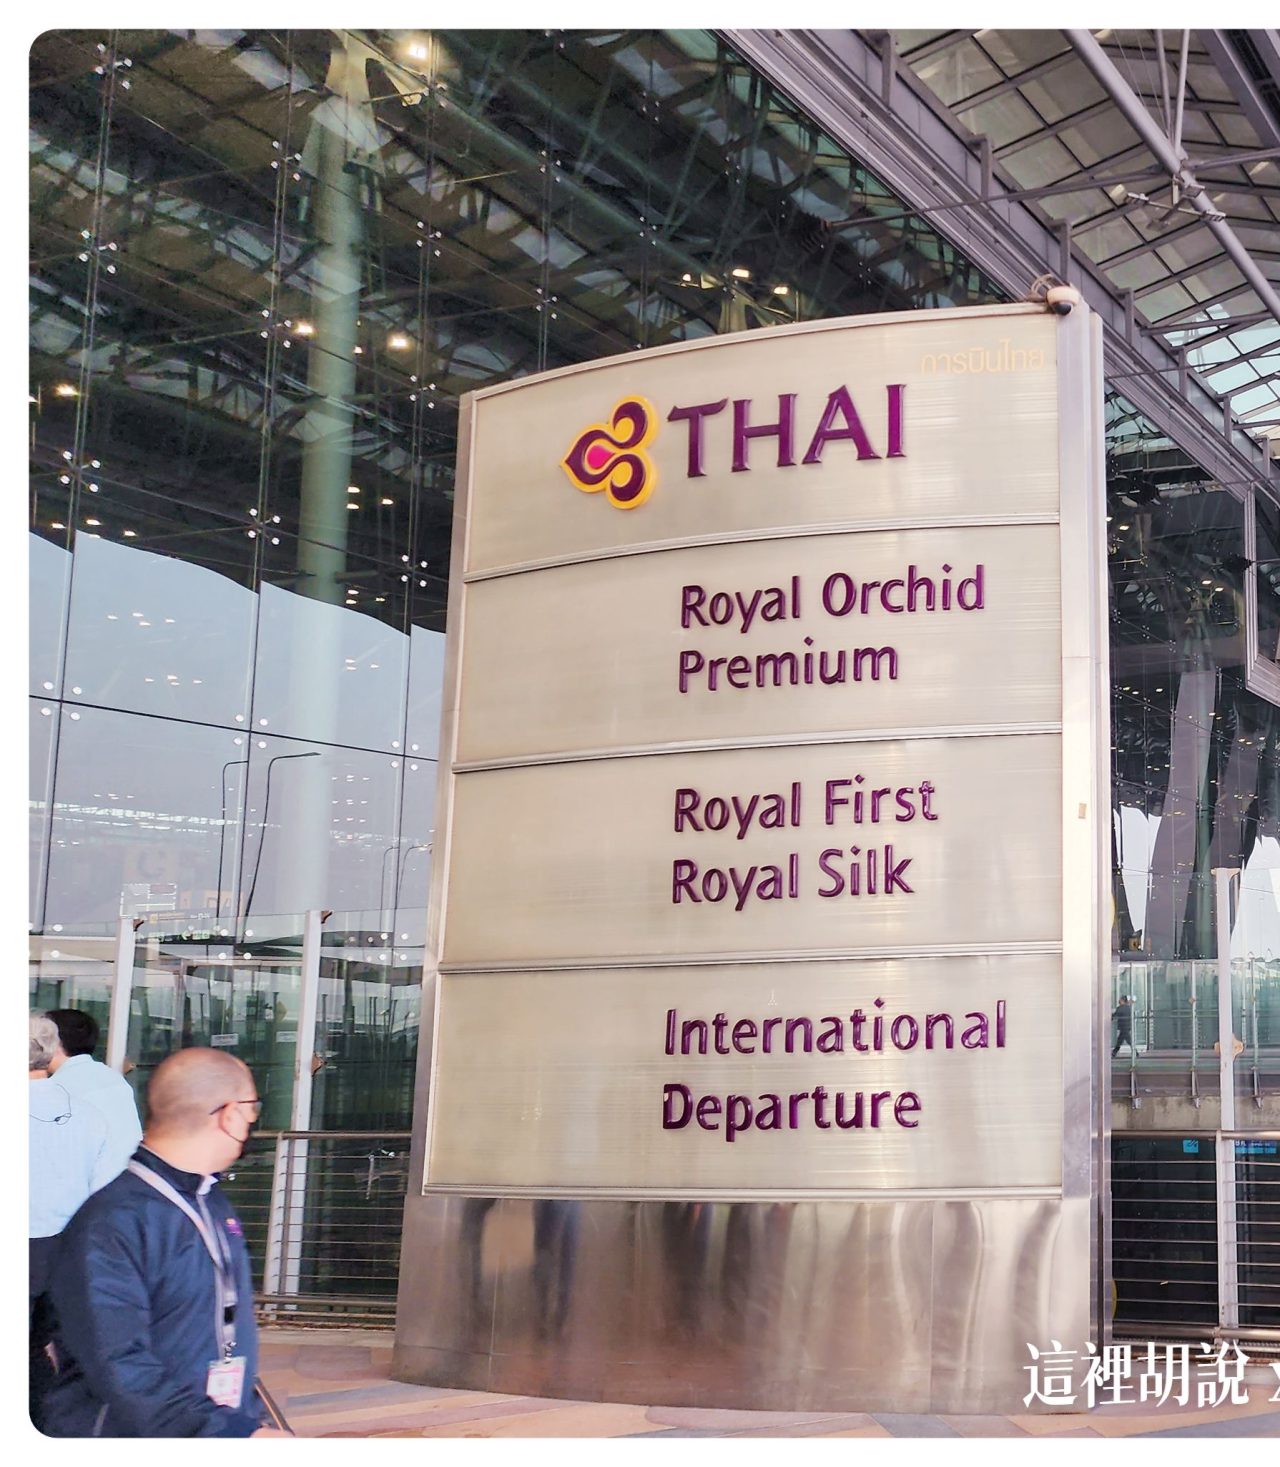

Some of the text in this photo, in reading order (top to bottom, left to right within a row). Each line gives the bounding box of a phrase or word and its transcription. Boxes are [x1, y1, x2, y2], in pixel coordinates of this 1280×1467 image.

[921, 337, 1045, 376] การบินไทย
[667, 384, 908, 478] THAI
[680, 563, 986, 633] Royal Orchid
[678, 636, 899, 694] Premium
[673, 774, 939, 839] Royal First
[671, 845, 915, 912] Royal Silk
[663, 996, 1007, 1056] International
[662, 1082, 922, 1142] Departure
